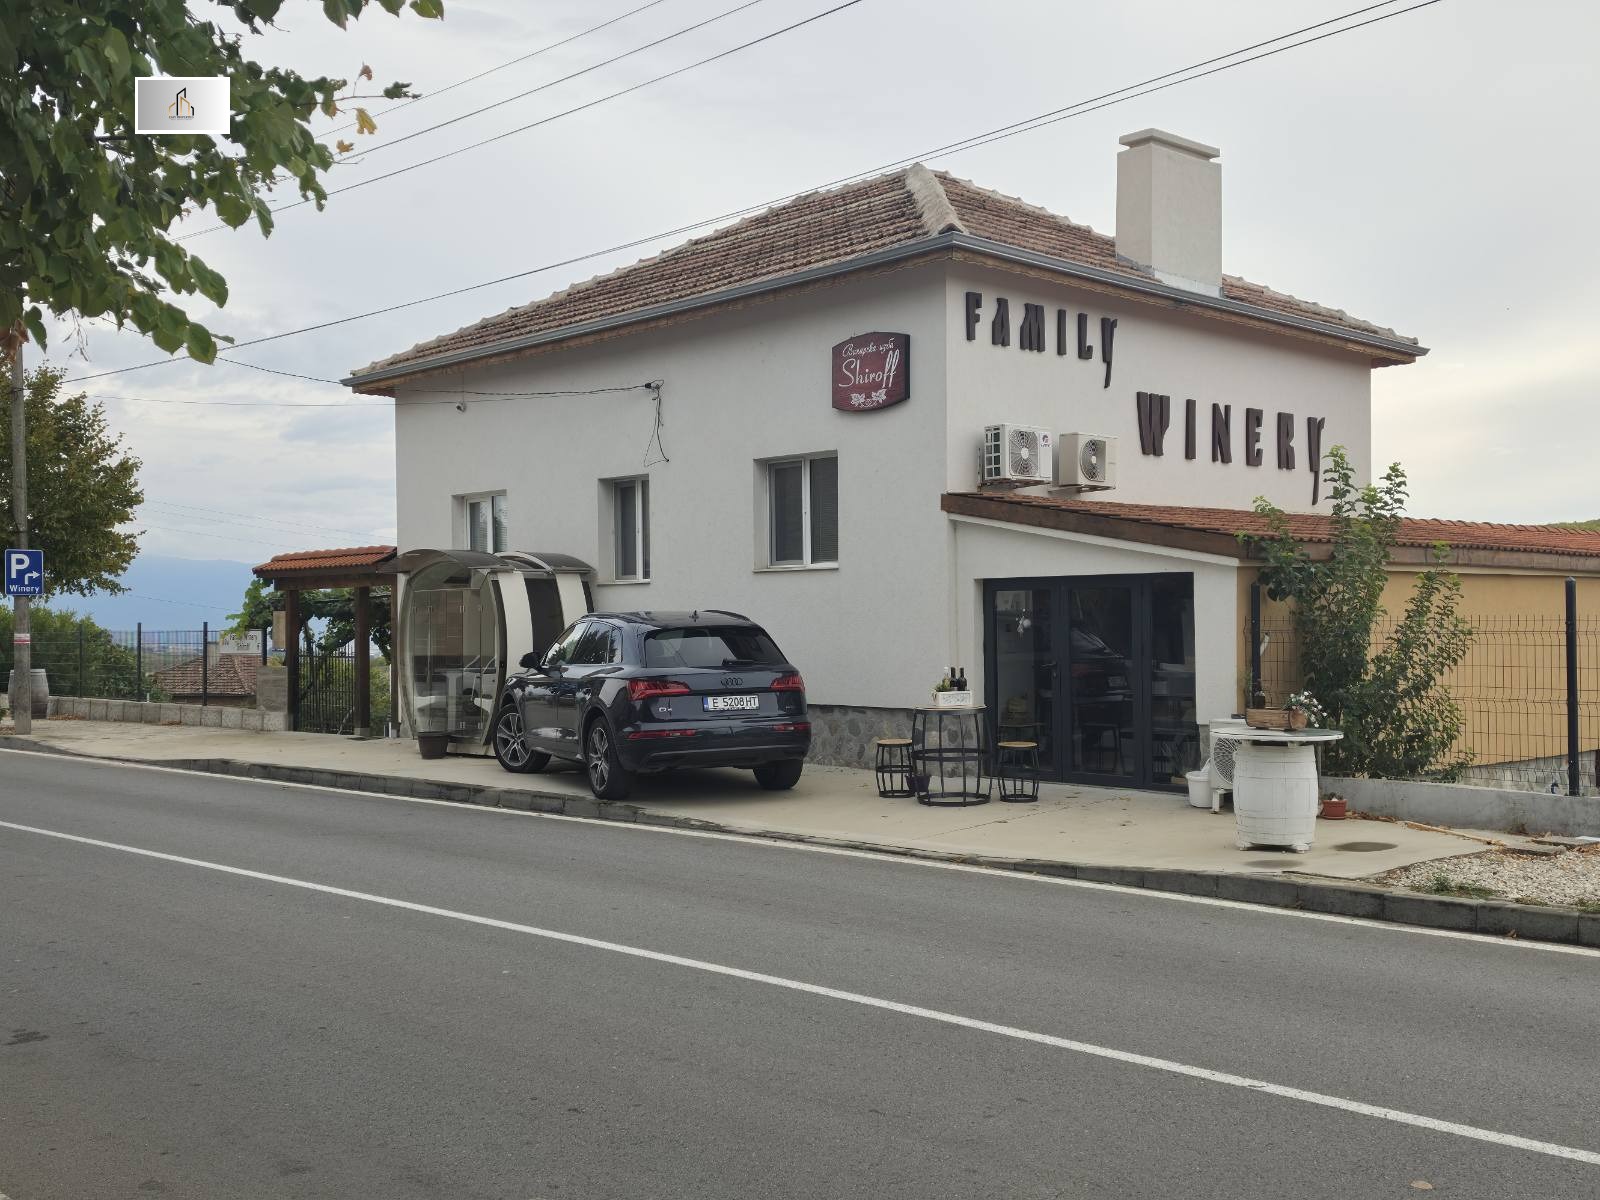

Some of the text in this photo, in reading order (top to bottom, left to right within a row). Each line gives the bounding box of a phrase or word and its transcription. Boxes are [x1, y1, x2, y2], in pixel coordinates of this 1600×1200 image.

[965, 291, 1118, 388] FAMILY
[839, 349, 899, 388] Shiroff
[1136, 391, 1325, 506] WINERY
[11, 553, 30, 578] P
[9, 584, 40, 594] Winery
